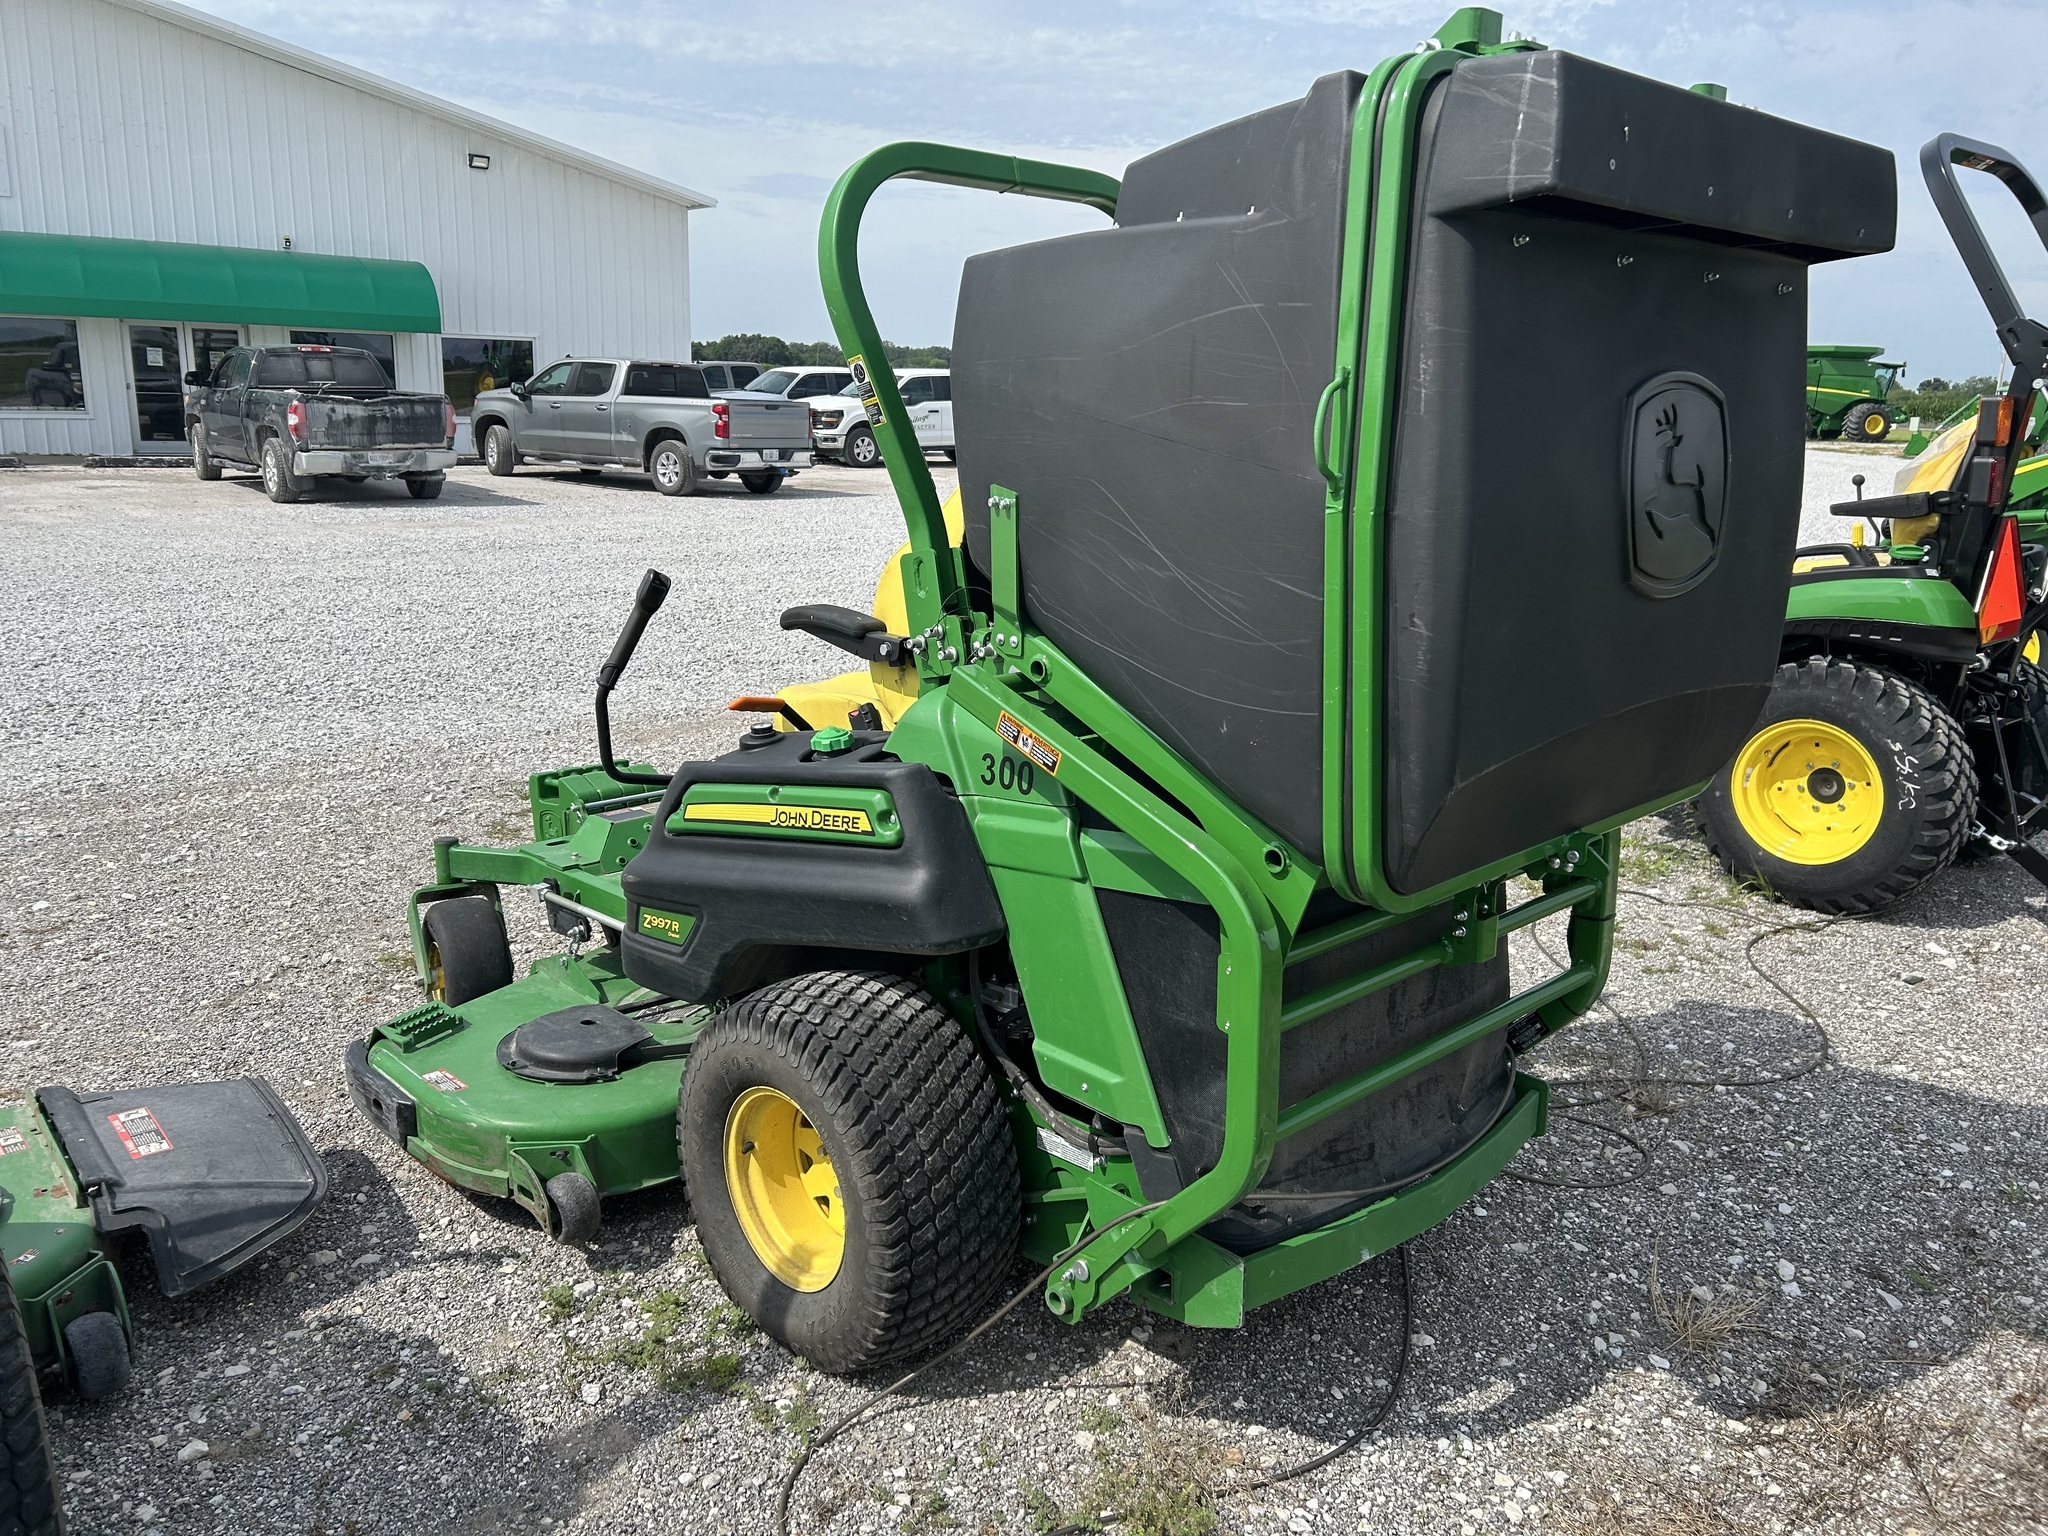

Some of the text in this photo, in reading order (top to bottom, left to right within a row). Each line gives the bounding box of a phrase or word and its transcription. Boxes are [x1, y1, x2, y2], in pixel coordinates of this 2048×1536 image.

[980, 752, 1034, 796] 300
[770, 807, 861, 830] JOHN DEERE
[643, 913, 680, 932] Z997R
